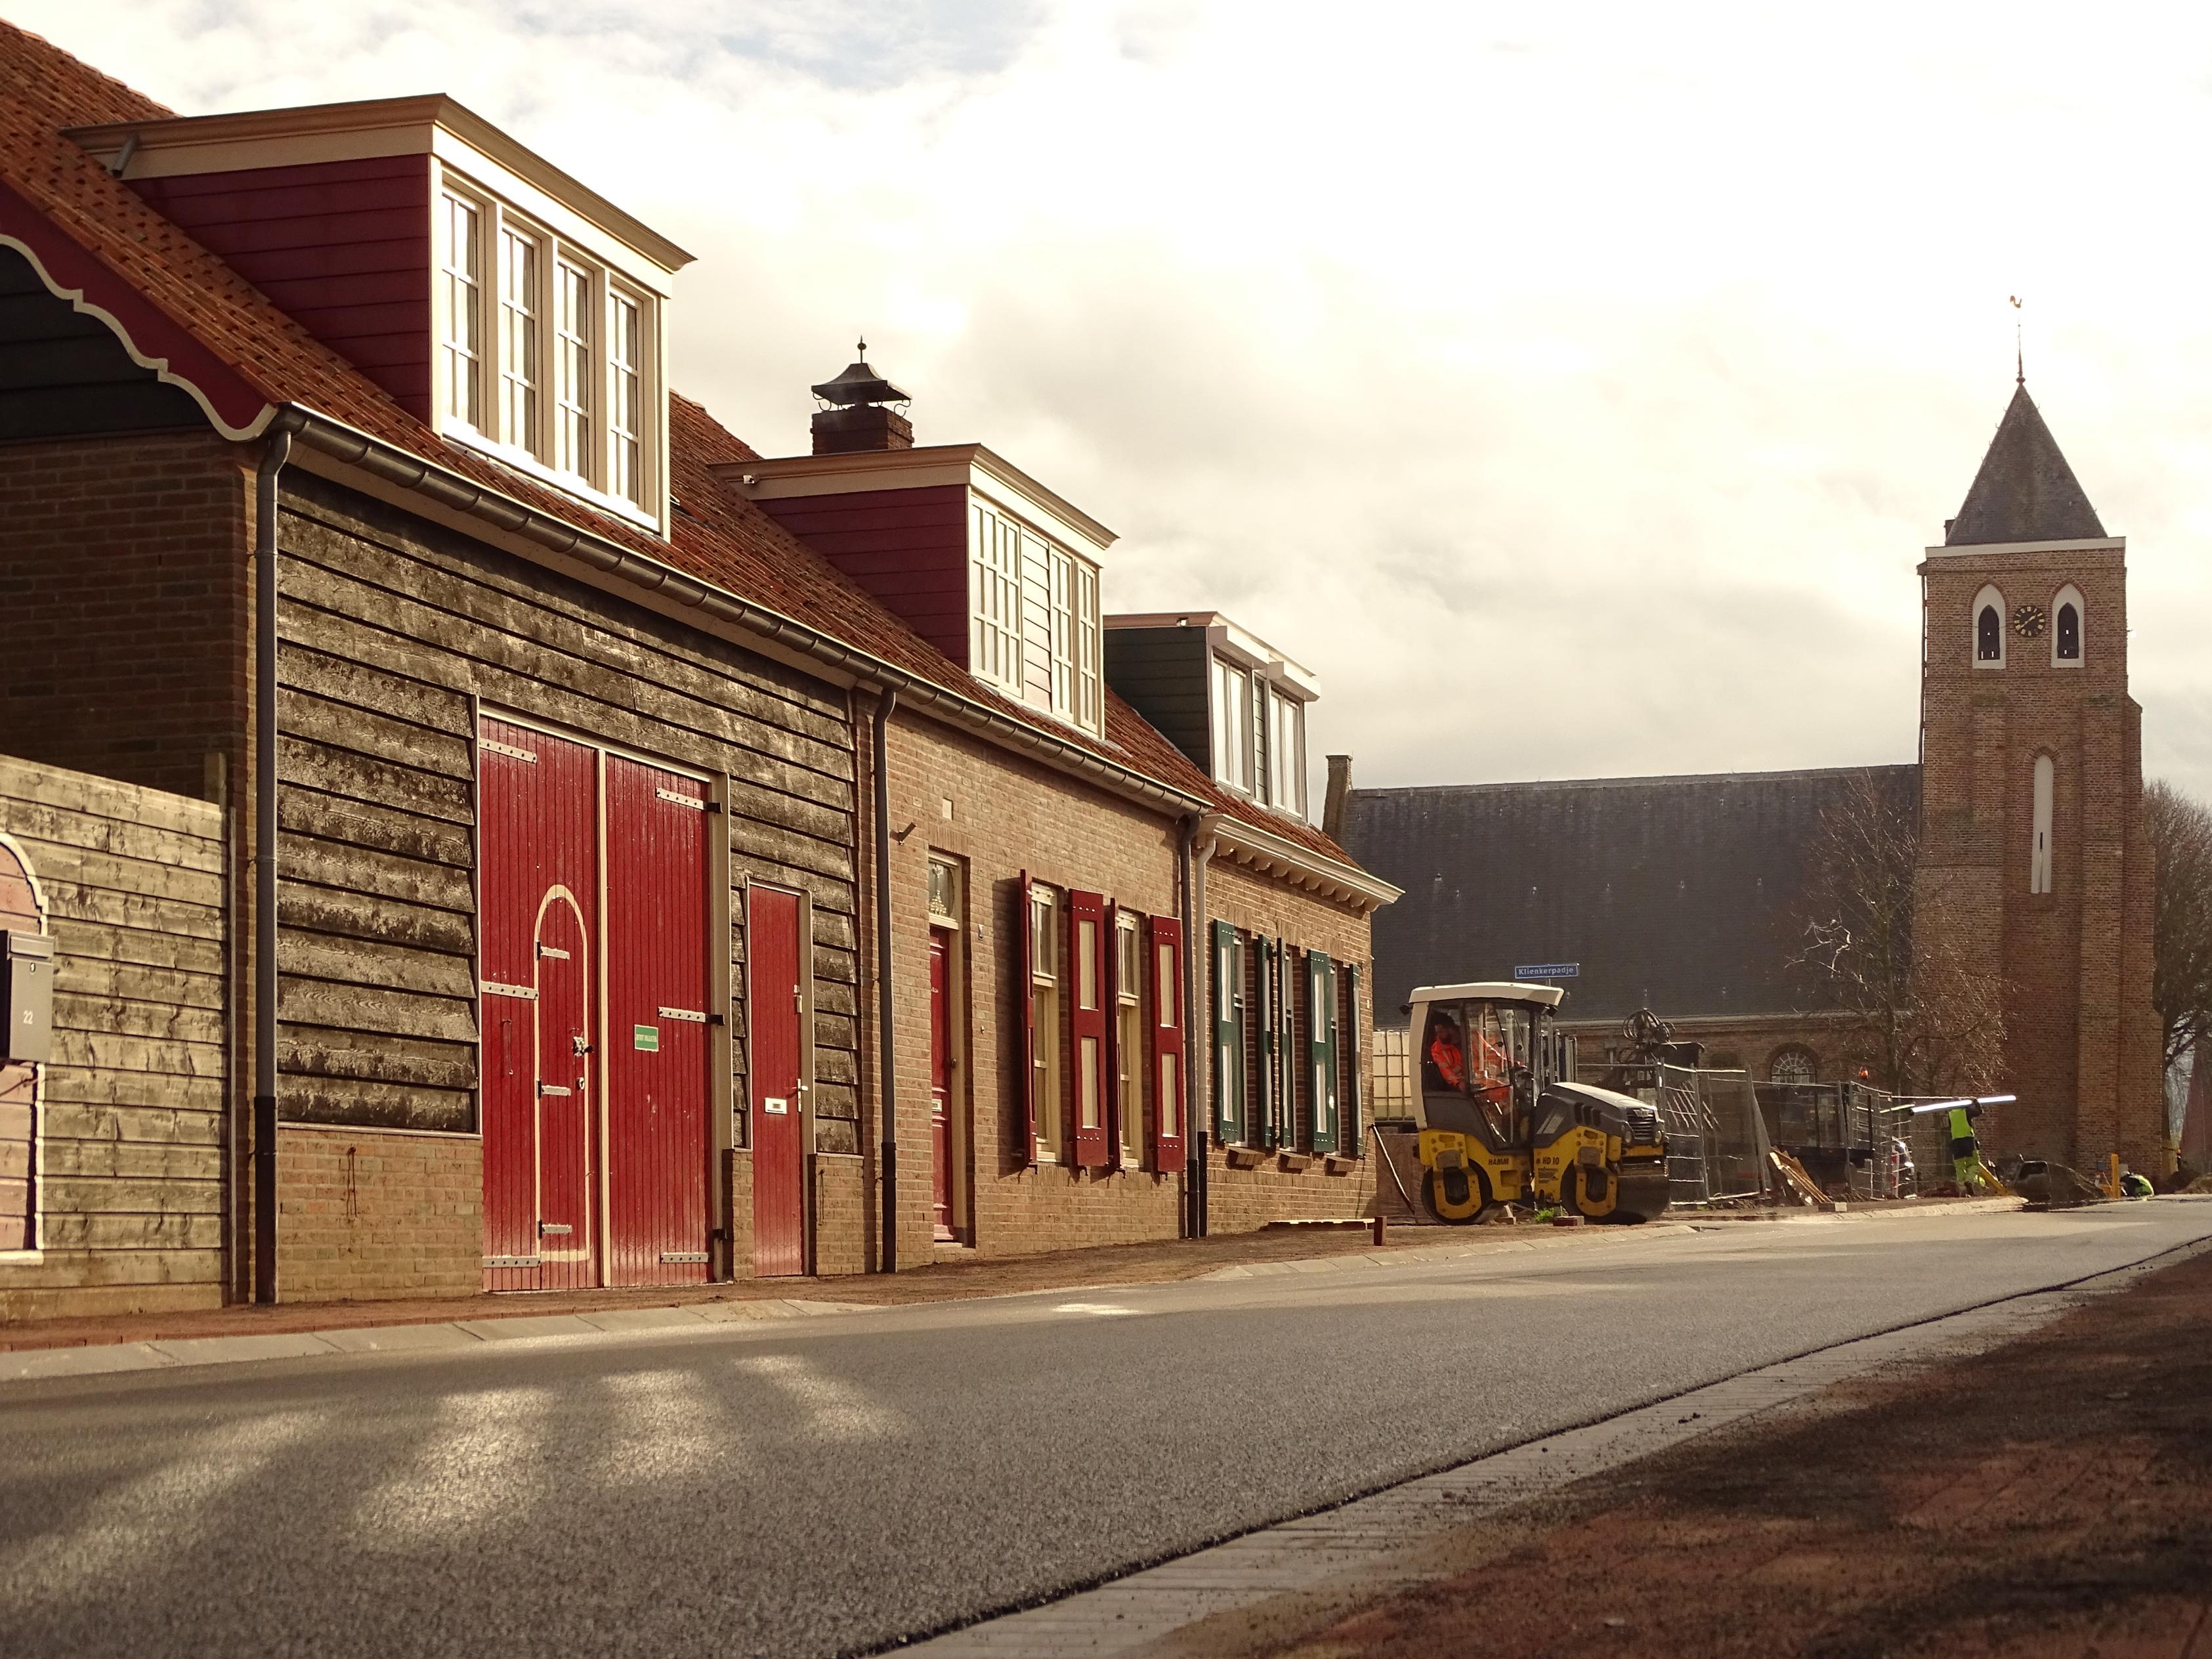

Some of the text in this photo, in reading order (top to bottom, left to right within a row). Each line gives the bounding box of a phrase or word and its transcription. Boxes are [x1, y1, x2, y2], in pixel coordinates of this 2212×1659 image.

[1518, 967, 1574, 976] Klienkerpadje
[23, 1010, 33, 1024] 22
[1542, 1157, 1560, 1165] HD 10
